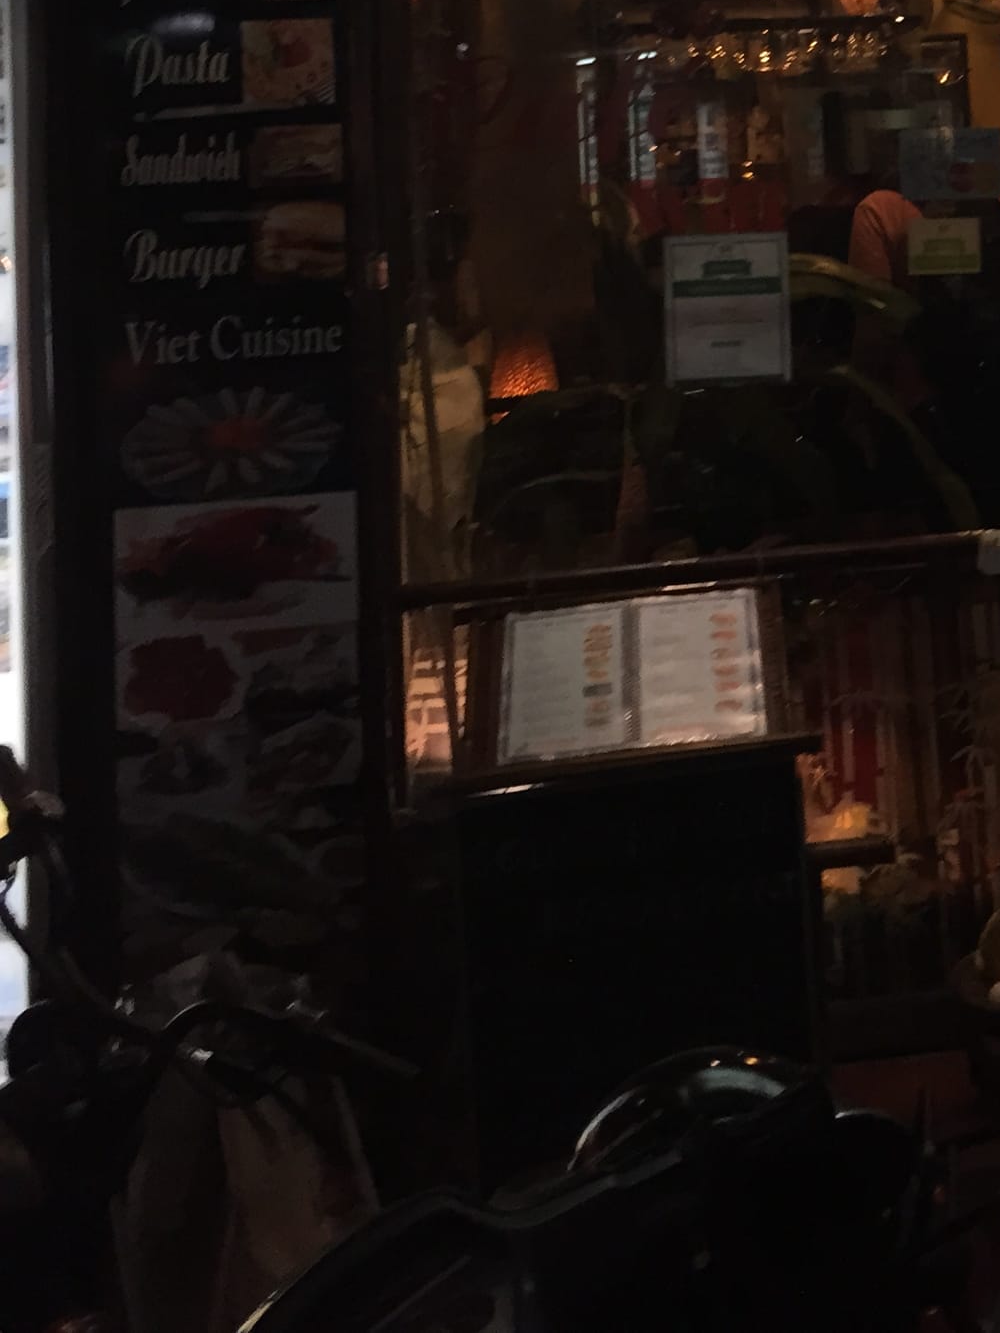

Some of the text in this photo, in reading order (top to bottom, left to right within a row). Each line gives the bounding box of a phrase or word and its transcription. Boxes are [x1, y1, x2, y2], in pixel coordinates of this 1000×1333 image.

[124, 32, 232, 98] Pasta
[120, 131, 241, 186] Sandwich
[123, 229, 247, 290] Burger
[124, 314, 344, 367] Viet Cuisine
